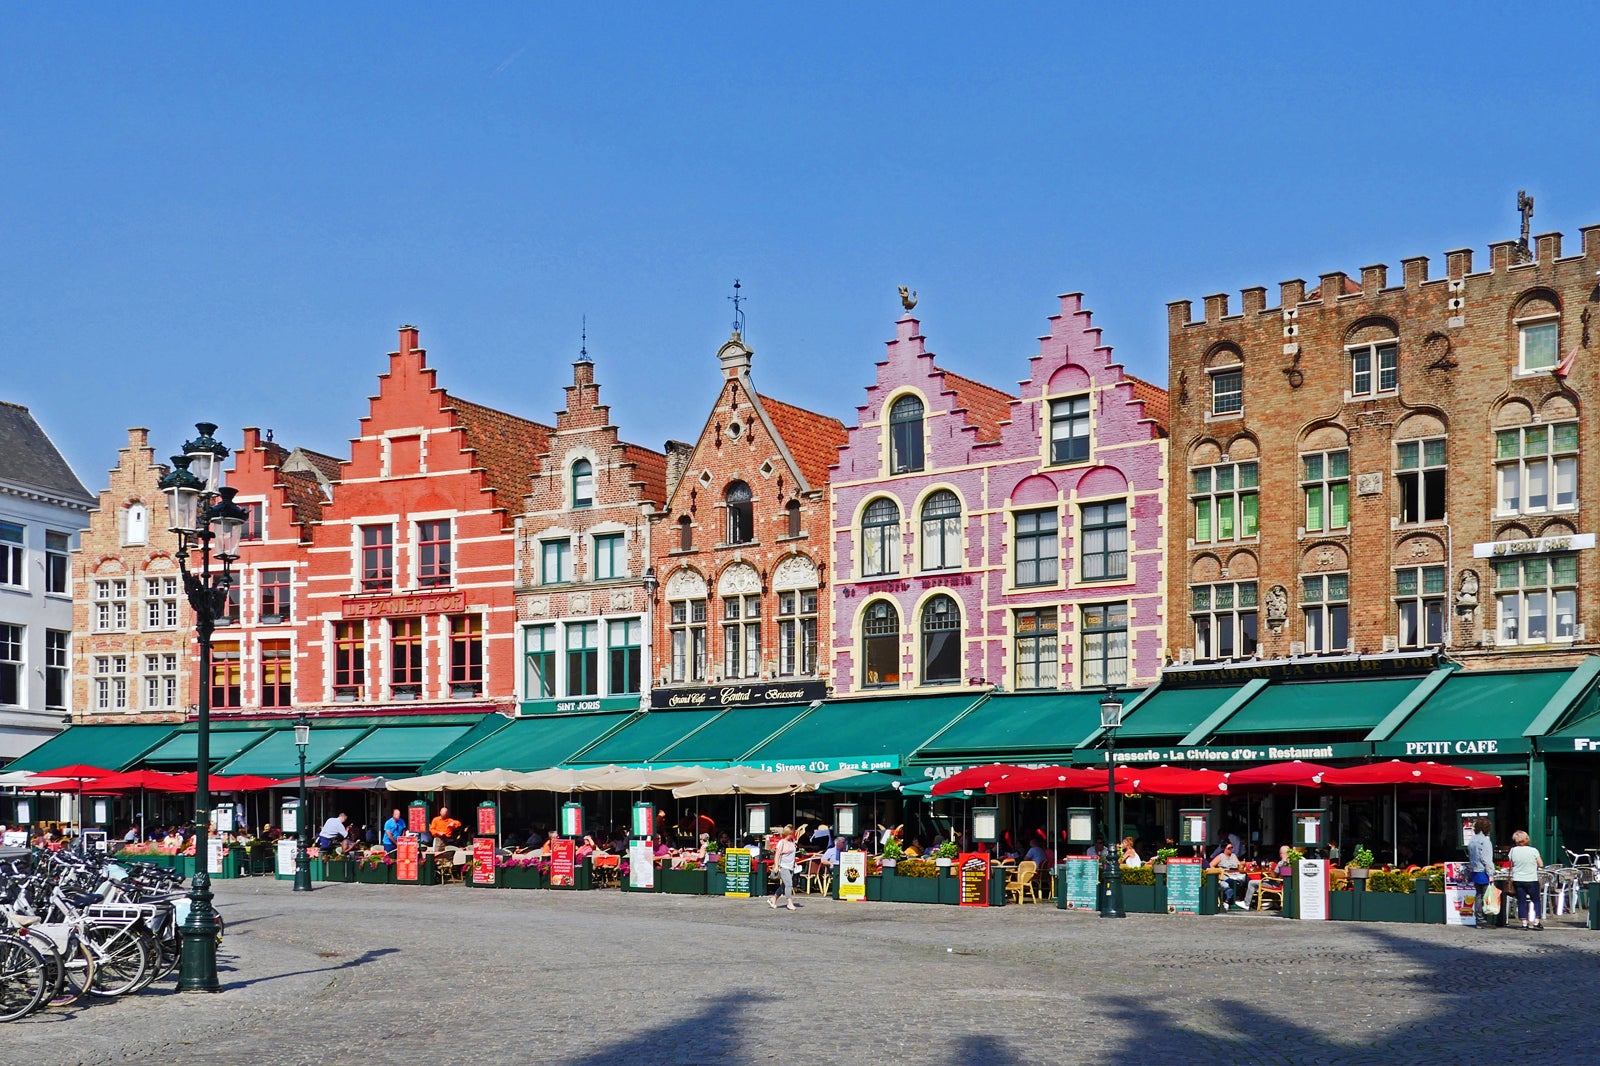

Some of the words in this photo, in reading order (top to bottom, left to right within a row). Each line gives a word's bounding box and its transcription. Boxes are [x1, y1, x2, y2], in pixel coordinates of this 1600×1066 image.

[1493, 543, 1507, 555] AU
[1510, 540, 1540, 553] PETIT
[1544, 537, 1572, 550] CAFE
[347, 602, 366, 616] LE
[368, 598, 423, 615] PANIER
[427, 595, 461, 612] D'OR
[1168, 667, 1272, 681] RESTAURANT
[1282, 665, 1304, 676] LA
[1394, 657, 1434, 669] D'OR
[720, 688, 751, 705] Central
[764, 688, 804, 700] Brasserie
[557, 702, 575, 711] SINT
[577, 701, 600, 710] JORIS
[1170, 750, 1185, 760] La
[1231, 748, 1257, 760] d'Or
[1268, 746, 1333, 759] Restaurant
[1406, 741, 1451, 755] PETIT
[1455, 740, 1498, 754] CAFE
[761, 763, 773, 772] La
[809, 761, 829, 771] d'Or
[839, 762, 859, 770] Pizza
[871, 761, 891, 770] pasta
